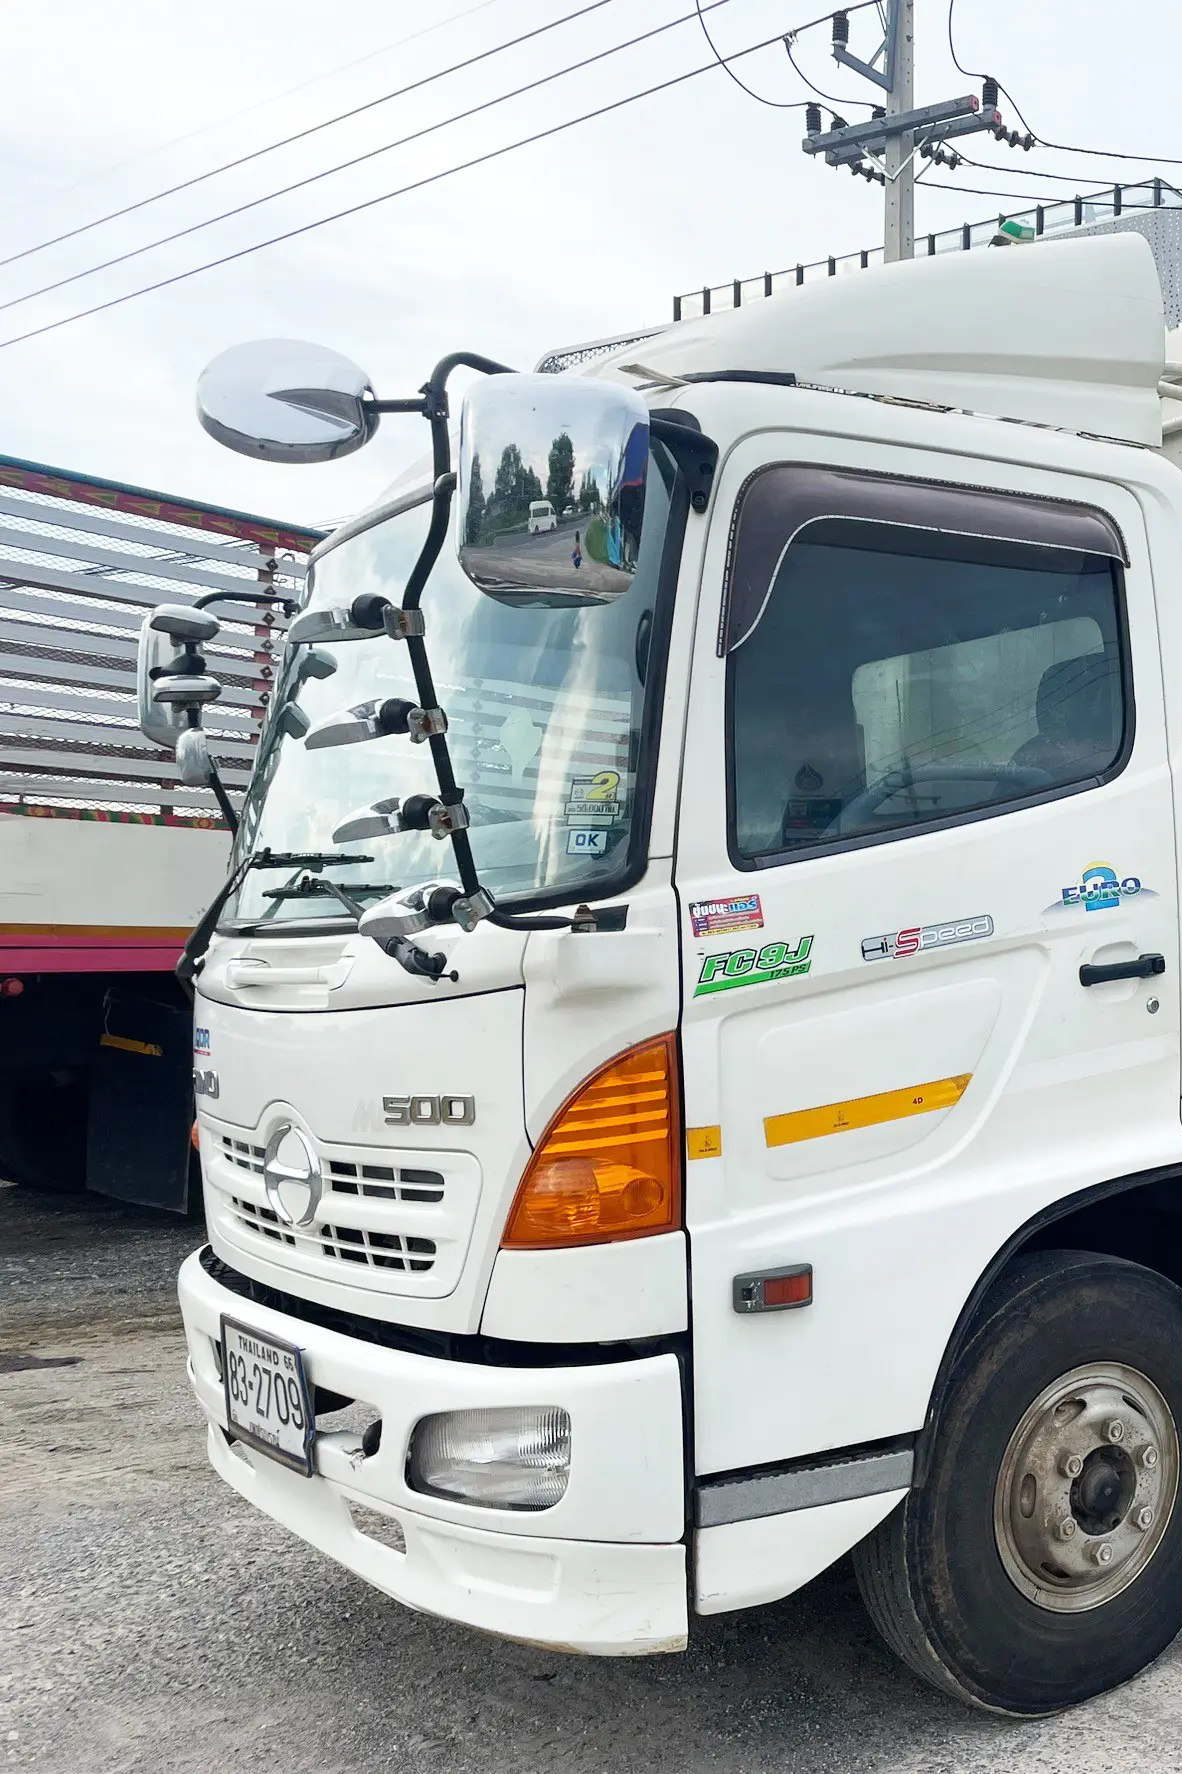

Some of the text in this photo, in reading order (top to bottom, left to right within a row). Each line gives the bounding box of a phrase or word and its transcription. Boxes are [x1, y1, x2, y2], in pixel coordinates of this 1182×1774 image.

[575, 833, 600, 847] OK
[1062, 877, 1141, 906] EURO
[861, 915, 990, 959] Hi-Speed
[382, 1093, 475, 1126] 500
[238, 1335, 279, 1366] THAILAND
[229, 1350, 304, 1430] 83-2709
